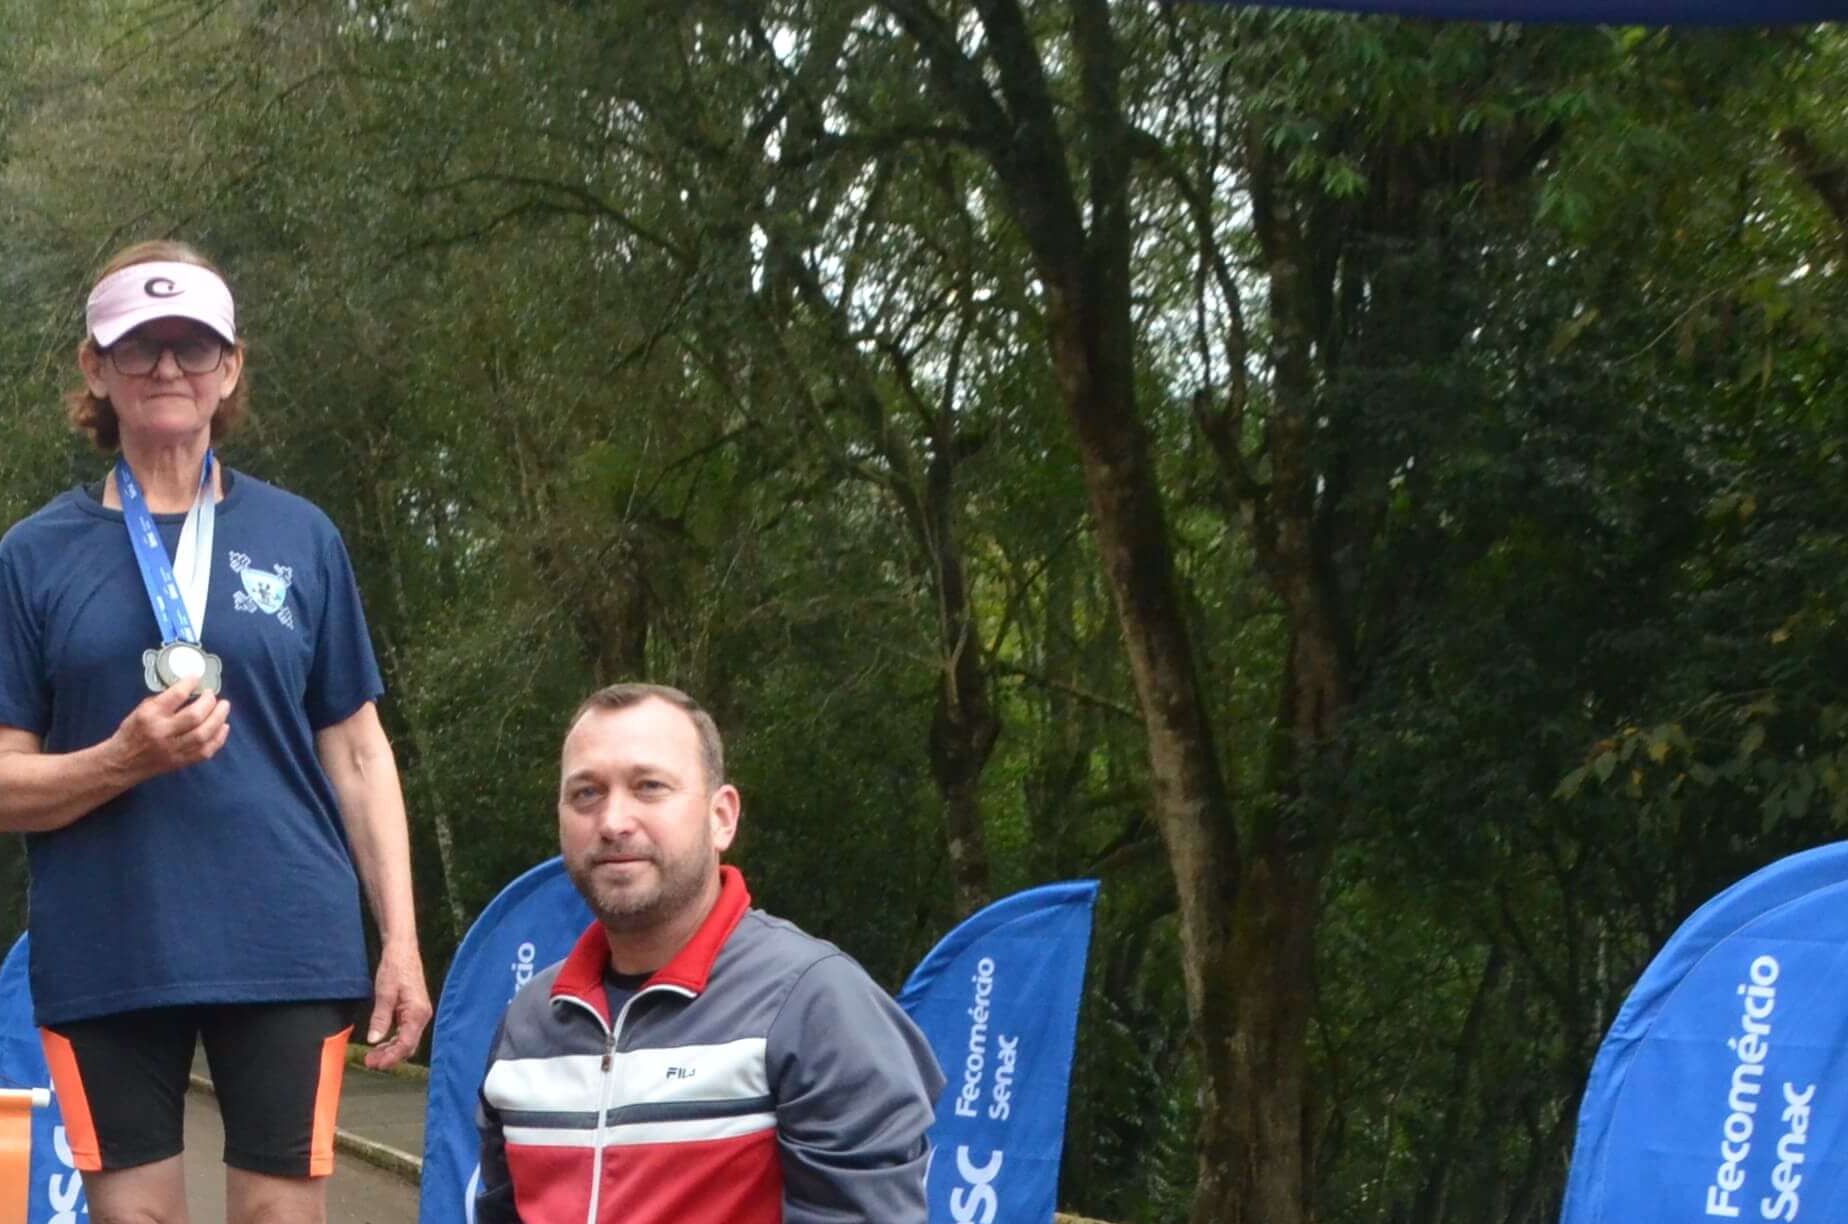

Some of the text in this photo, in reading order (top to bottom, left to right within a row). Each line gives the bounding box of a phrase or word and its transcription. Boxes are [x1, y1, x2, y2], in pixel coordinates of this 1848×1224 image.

[955, 957, 996, 1119] Fecomércio
[988, 1034, 1019, 1121] Senac
[1706, 955, 1780, 1218] Fecomércio
[1761, 1081, 1816, 1222] Senac
